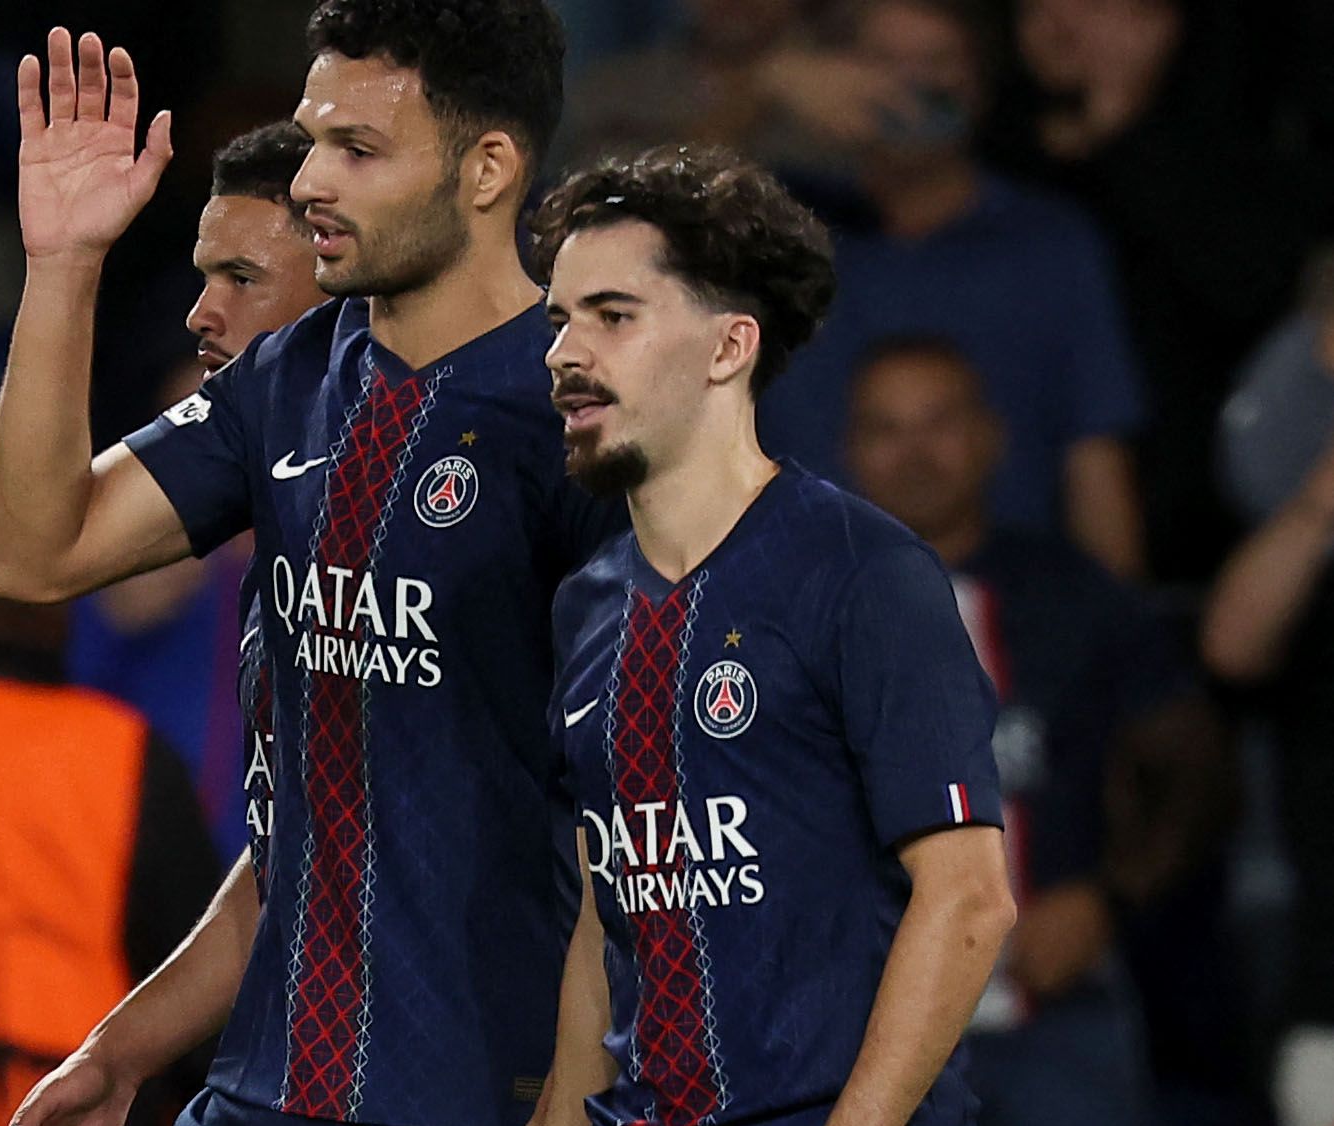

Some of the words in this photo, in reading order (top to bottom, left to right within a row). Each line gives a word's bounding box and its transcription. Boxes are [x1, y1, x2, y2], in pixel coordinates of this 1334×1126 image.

[434, 460, 473, 480] PARIS
[273, 555, 438, 643] QATAR
[294, 631, 442, 688] AIRWAYS
[706, 665, 746, 685] PARIS
[582, 795, 759, 885] QATAR
[616, 862, 765, 915] AIRWAYS
